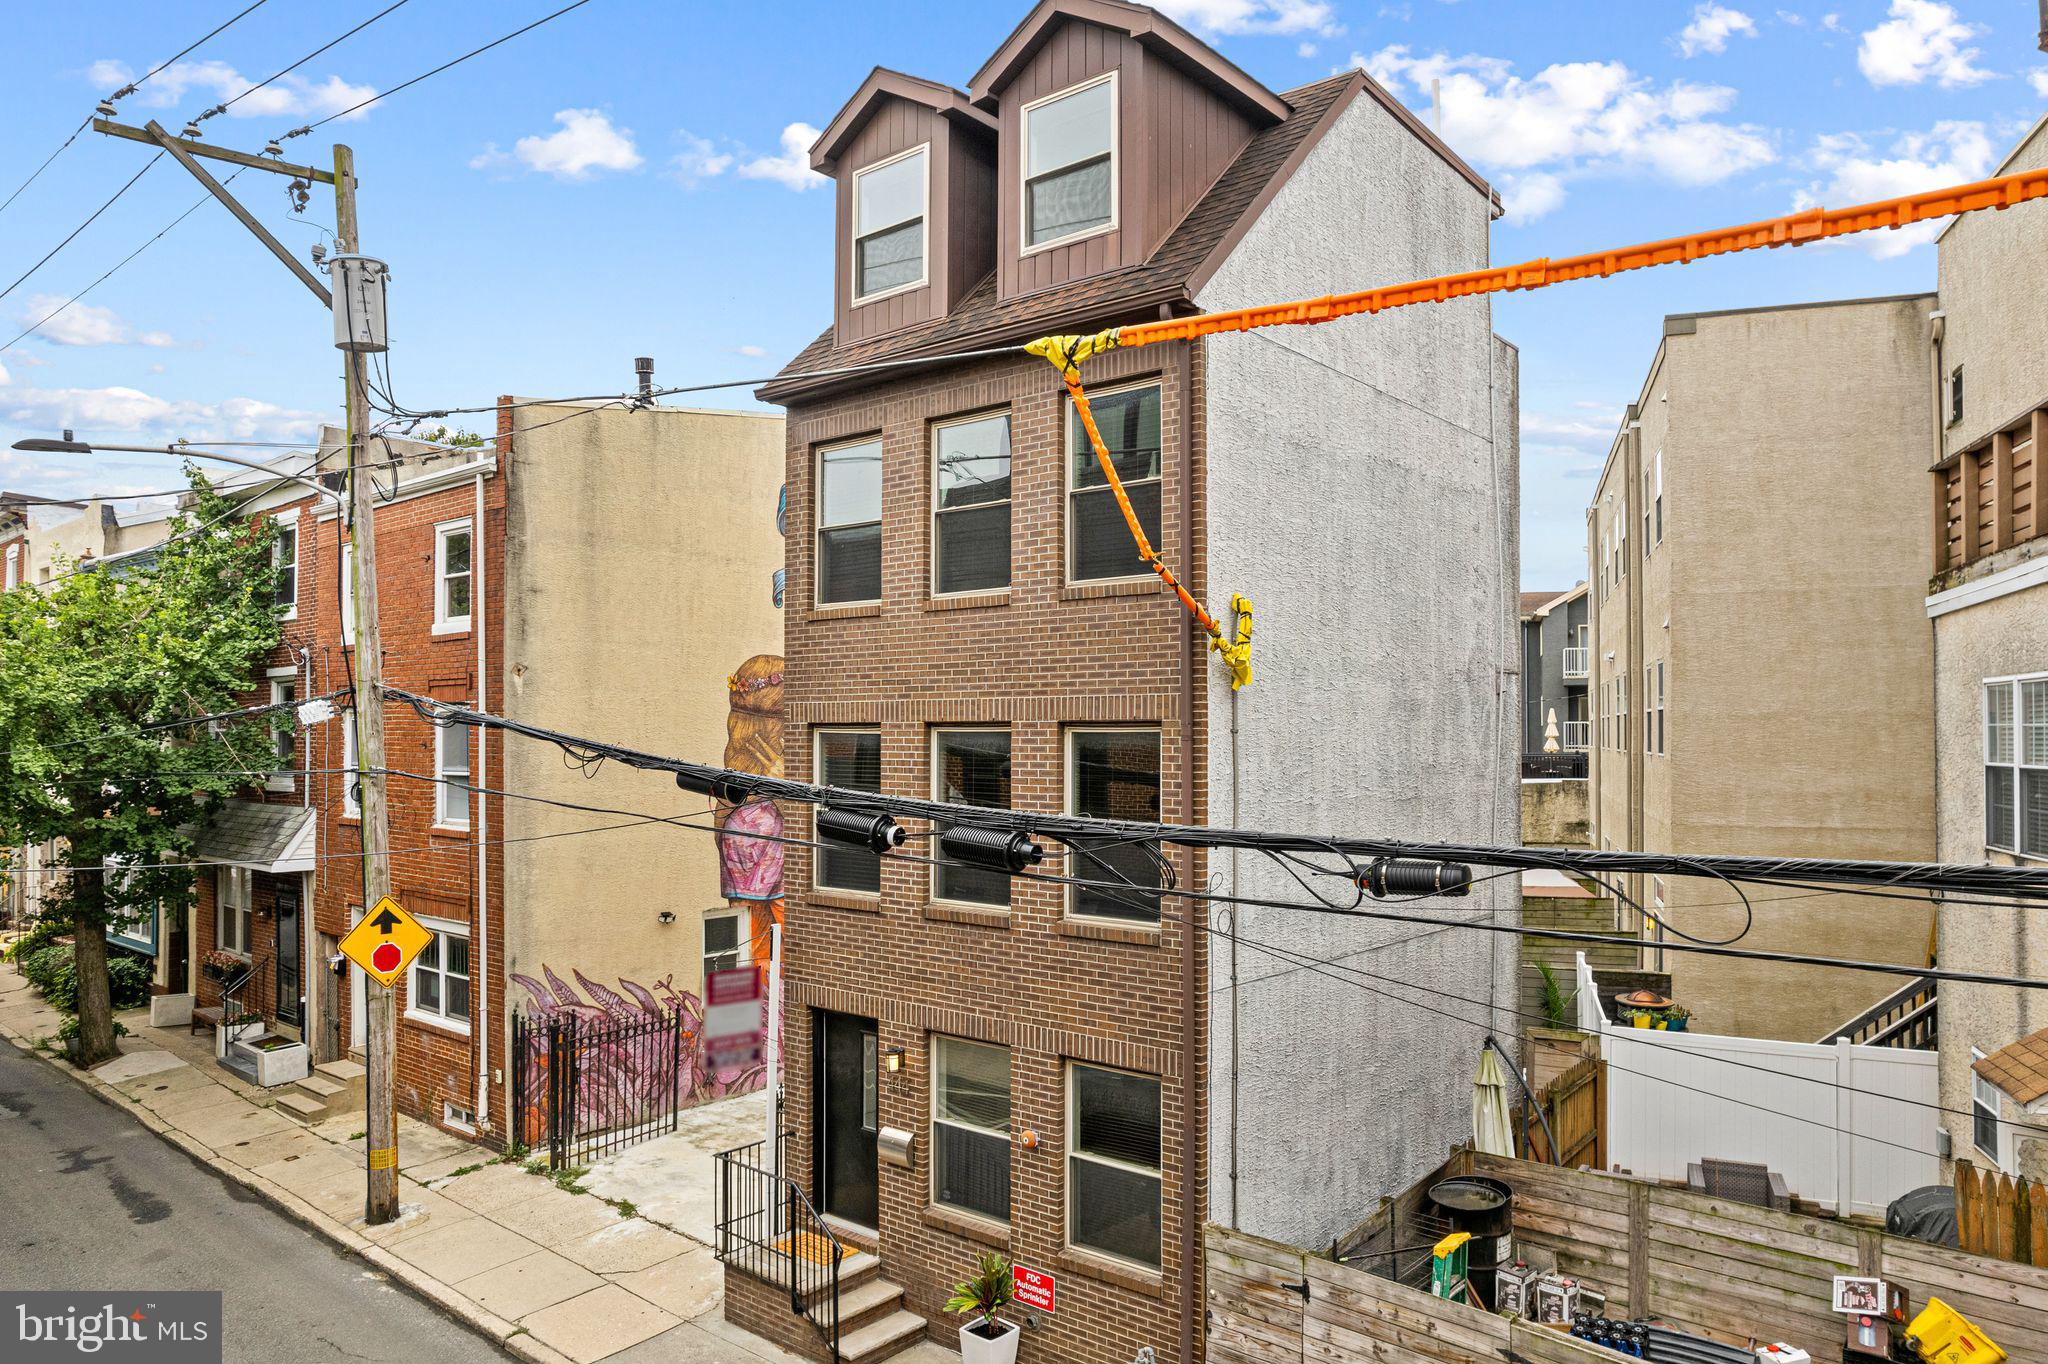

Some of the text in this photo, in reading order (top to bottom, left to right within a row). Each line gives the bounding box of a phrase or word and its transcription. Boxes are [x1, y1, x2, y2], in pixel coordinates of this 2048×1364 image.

[1026, 1273, 1041, 1285] FDC
[1016, 1279, 1052, 1298] Automatic
[1018, 1289, 1049, 1306] Sprinkler
